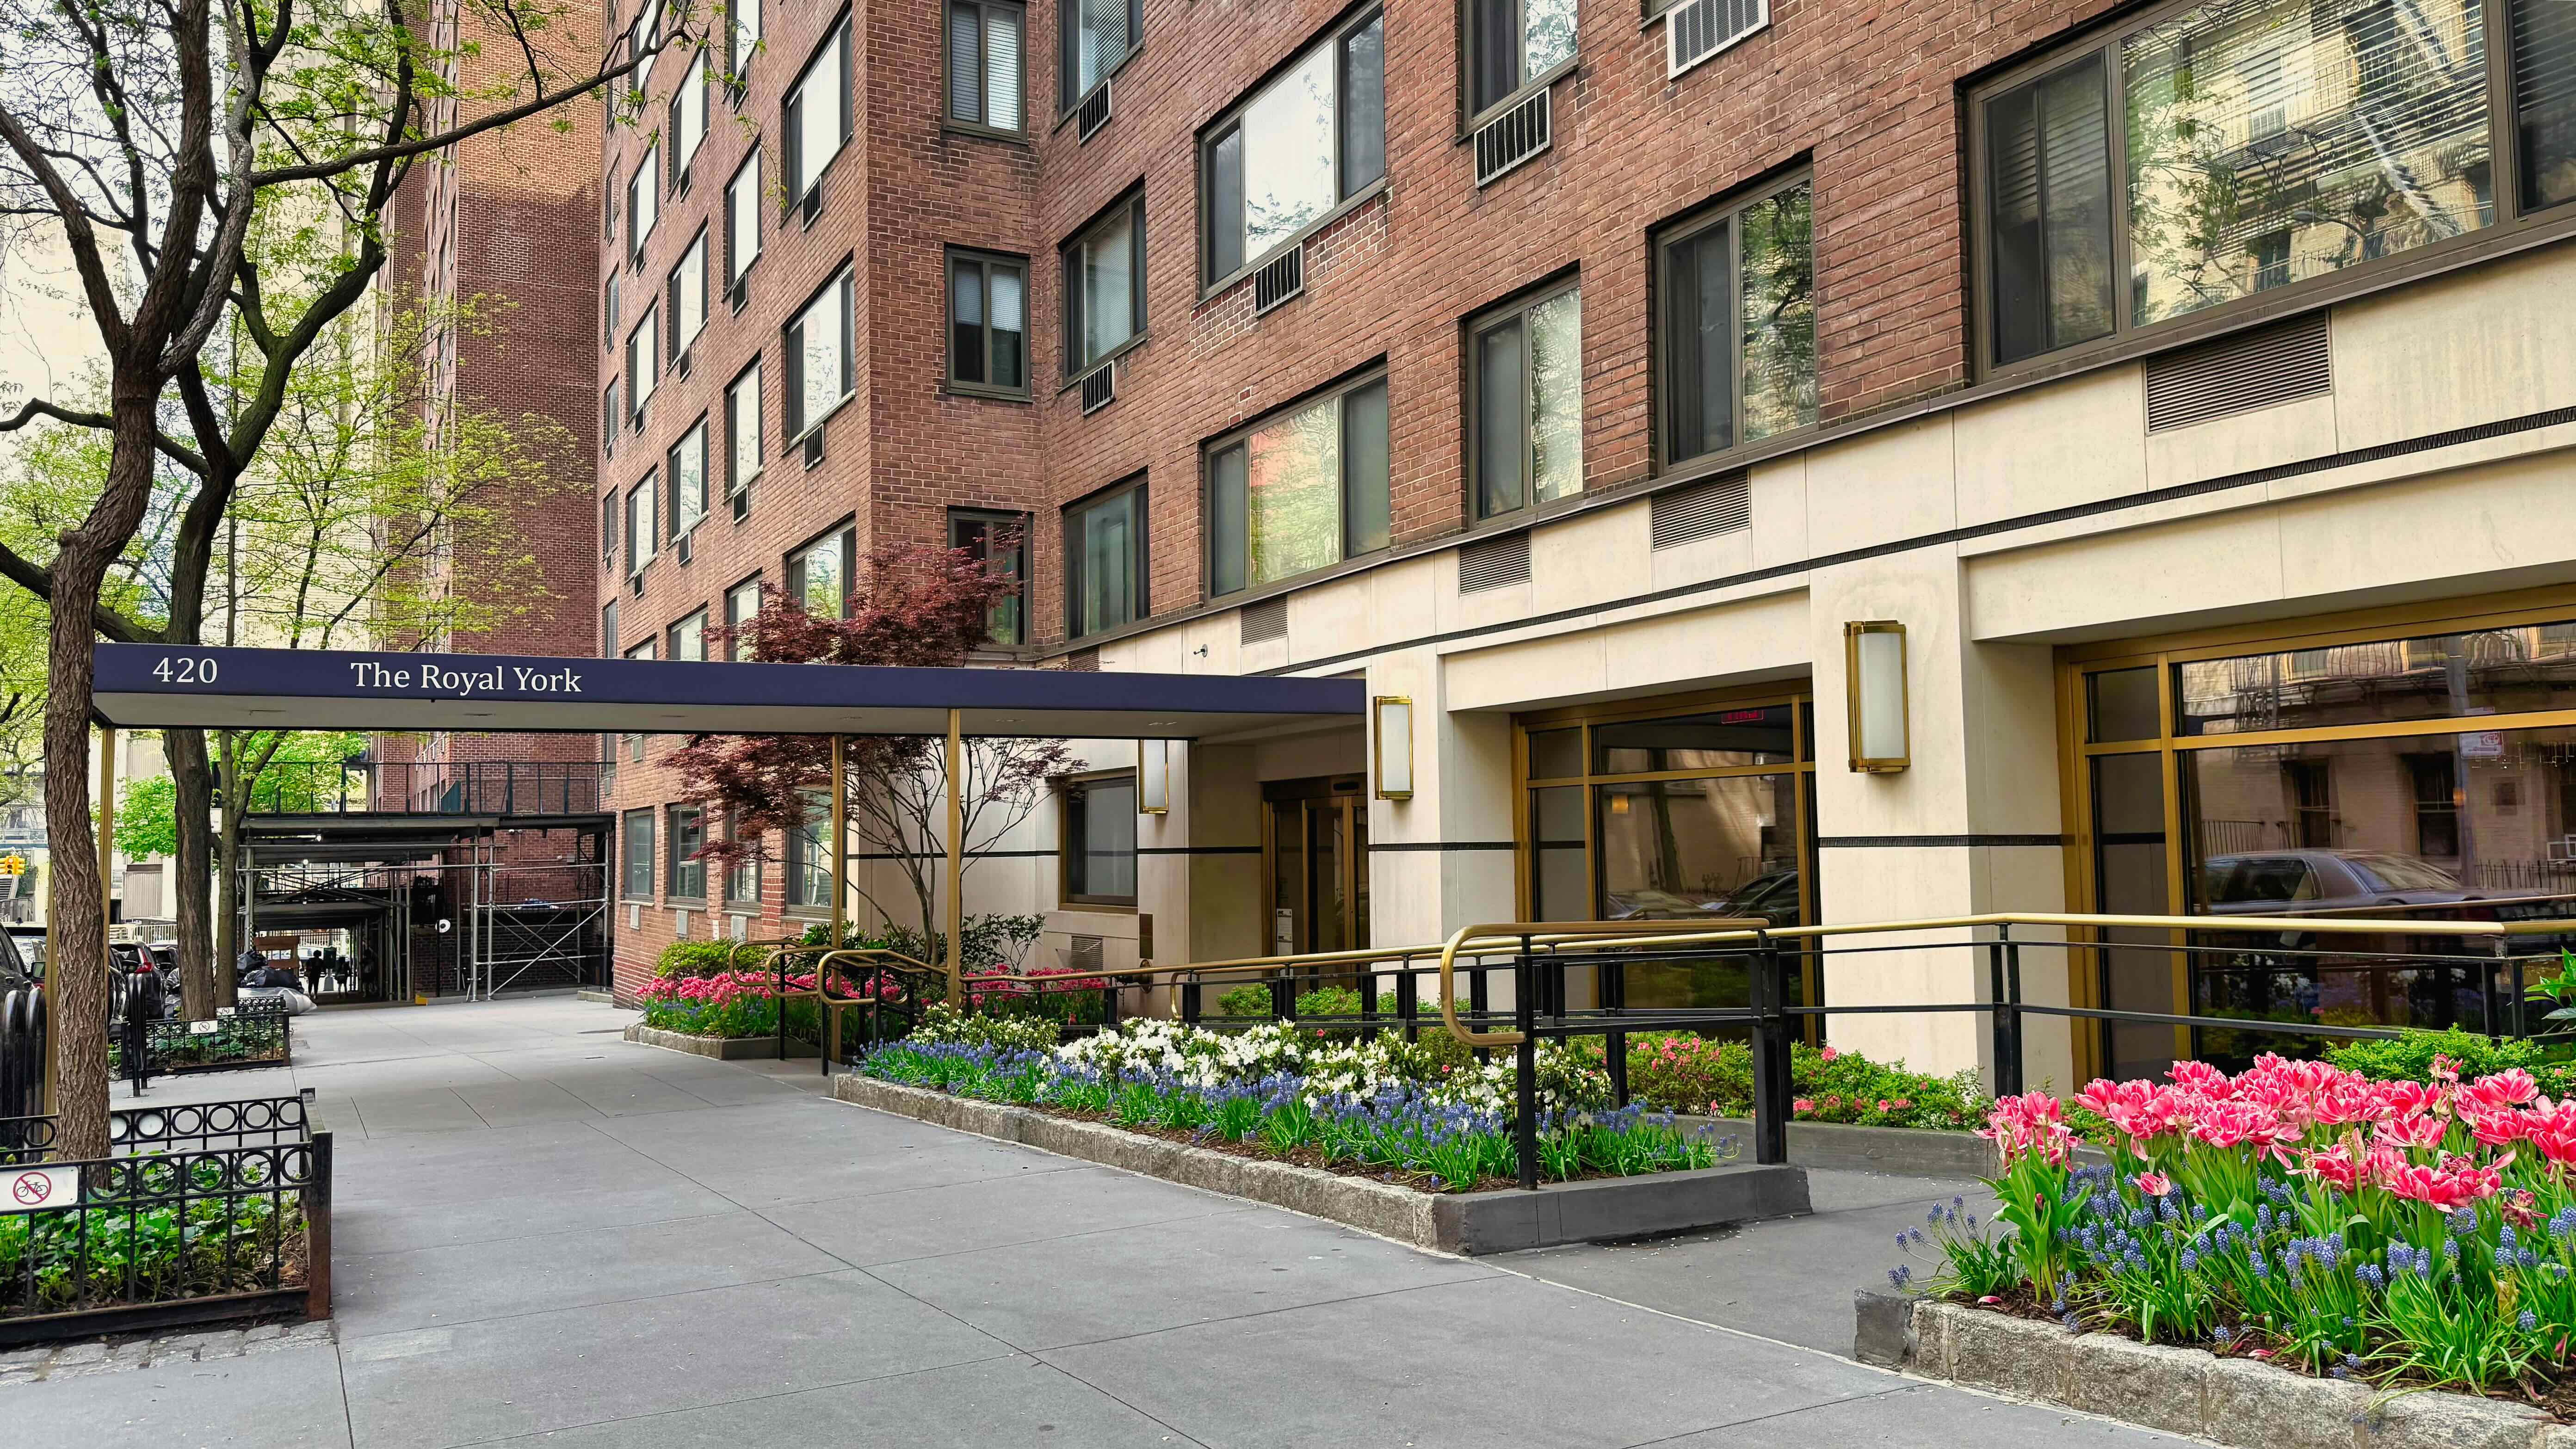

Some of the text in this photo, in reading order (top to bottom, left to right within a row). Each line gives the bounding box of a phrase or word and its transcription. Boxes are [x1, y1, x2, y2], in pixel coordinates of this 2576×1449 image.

[153, 657, 217, 683] 420
[350, 662, 582, 696] The Royal York
